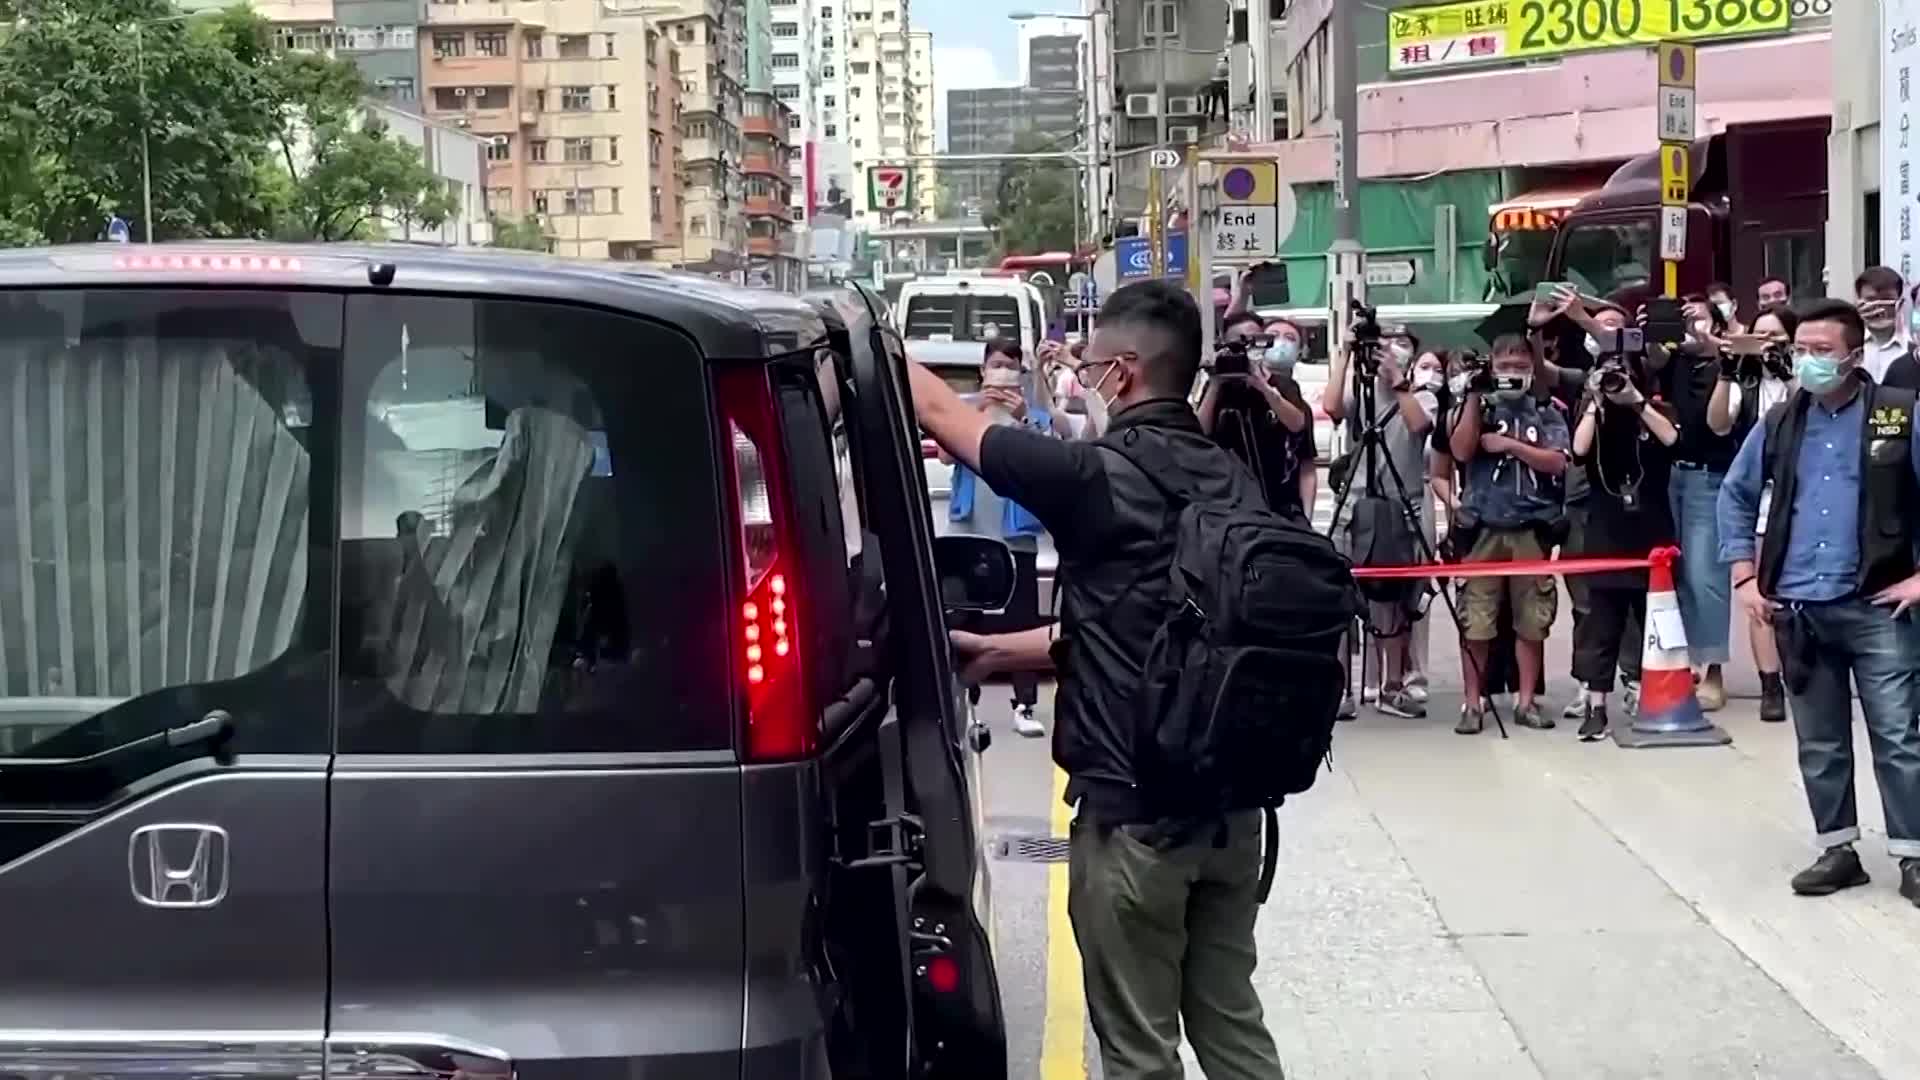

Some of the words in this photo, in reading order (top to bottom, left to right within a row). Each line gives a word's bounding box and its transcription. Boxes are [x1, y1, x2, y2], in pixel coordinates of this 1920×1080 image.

[1520, 0, 1641, 48] 2300
[879, 173, 902, 188] 7
[1224, 212, 1255, 226] End
